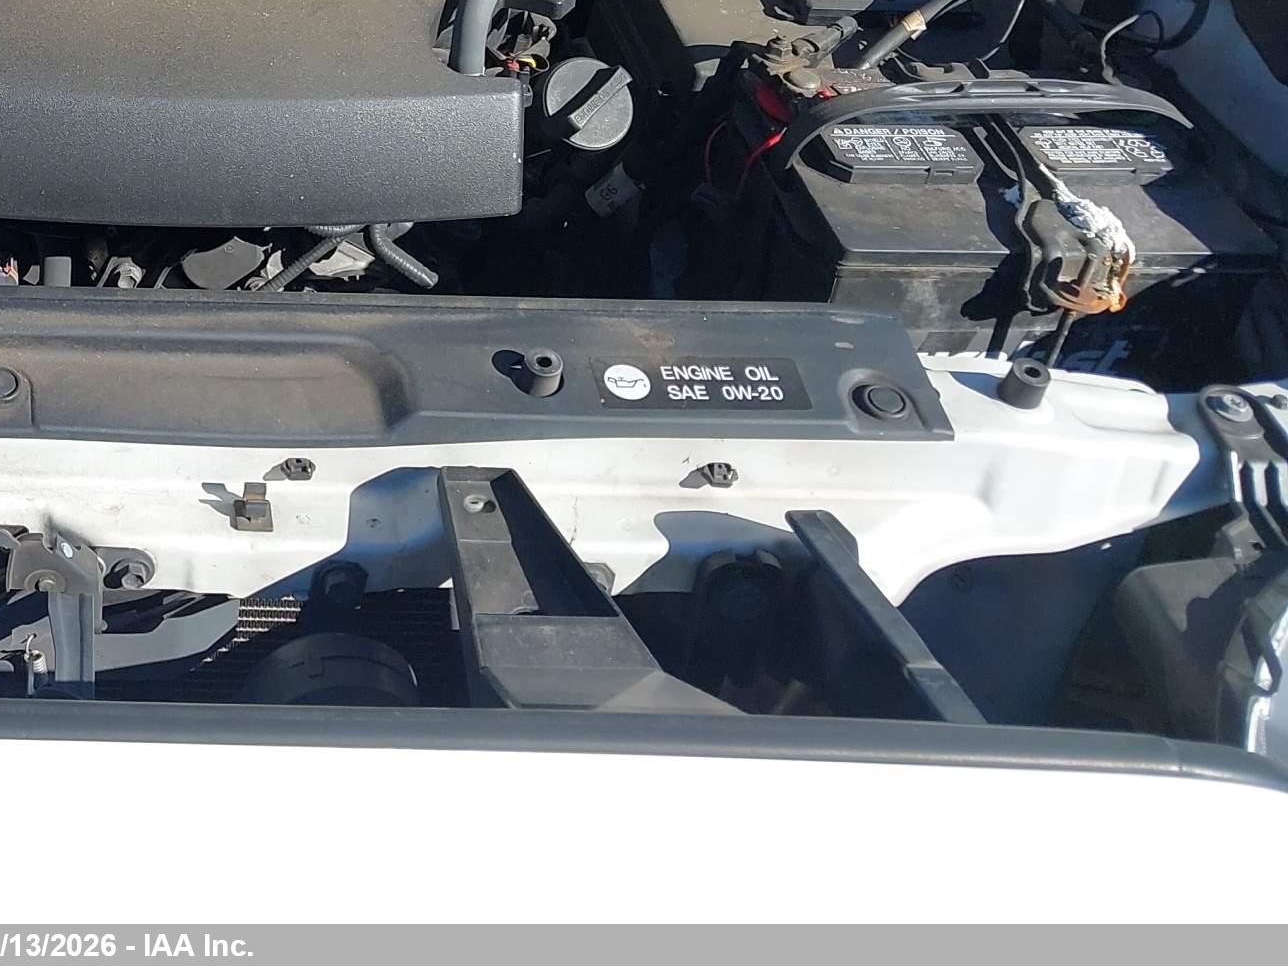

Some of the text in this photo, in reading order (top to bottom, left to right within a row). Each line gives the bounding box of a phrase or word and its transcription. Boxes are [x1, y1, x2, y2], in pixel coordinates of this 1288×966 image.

[660, 365, 779, 382] ENGINE OIL
[667, 385, 784, 402] SAE 0W-20
